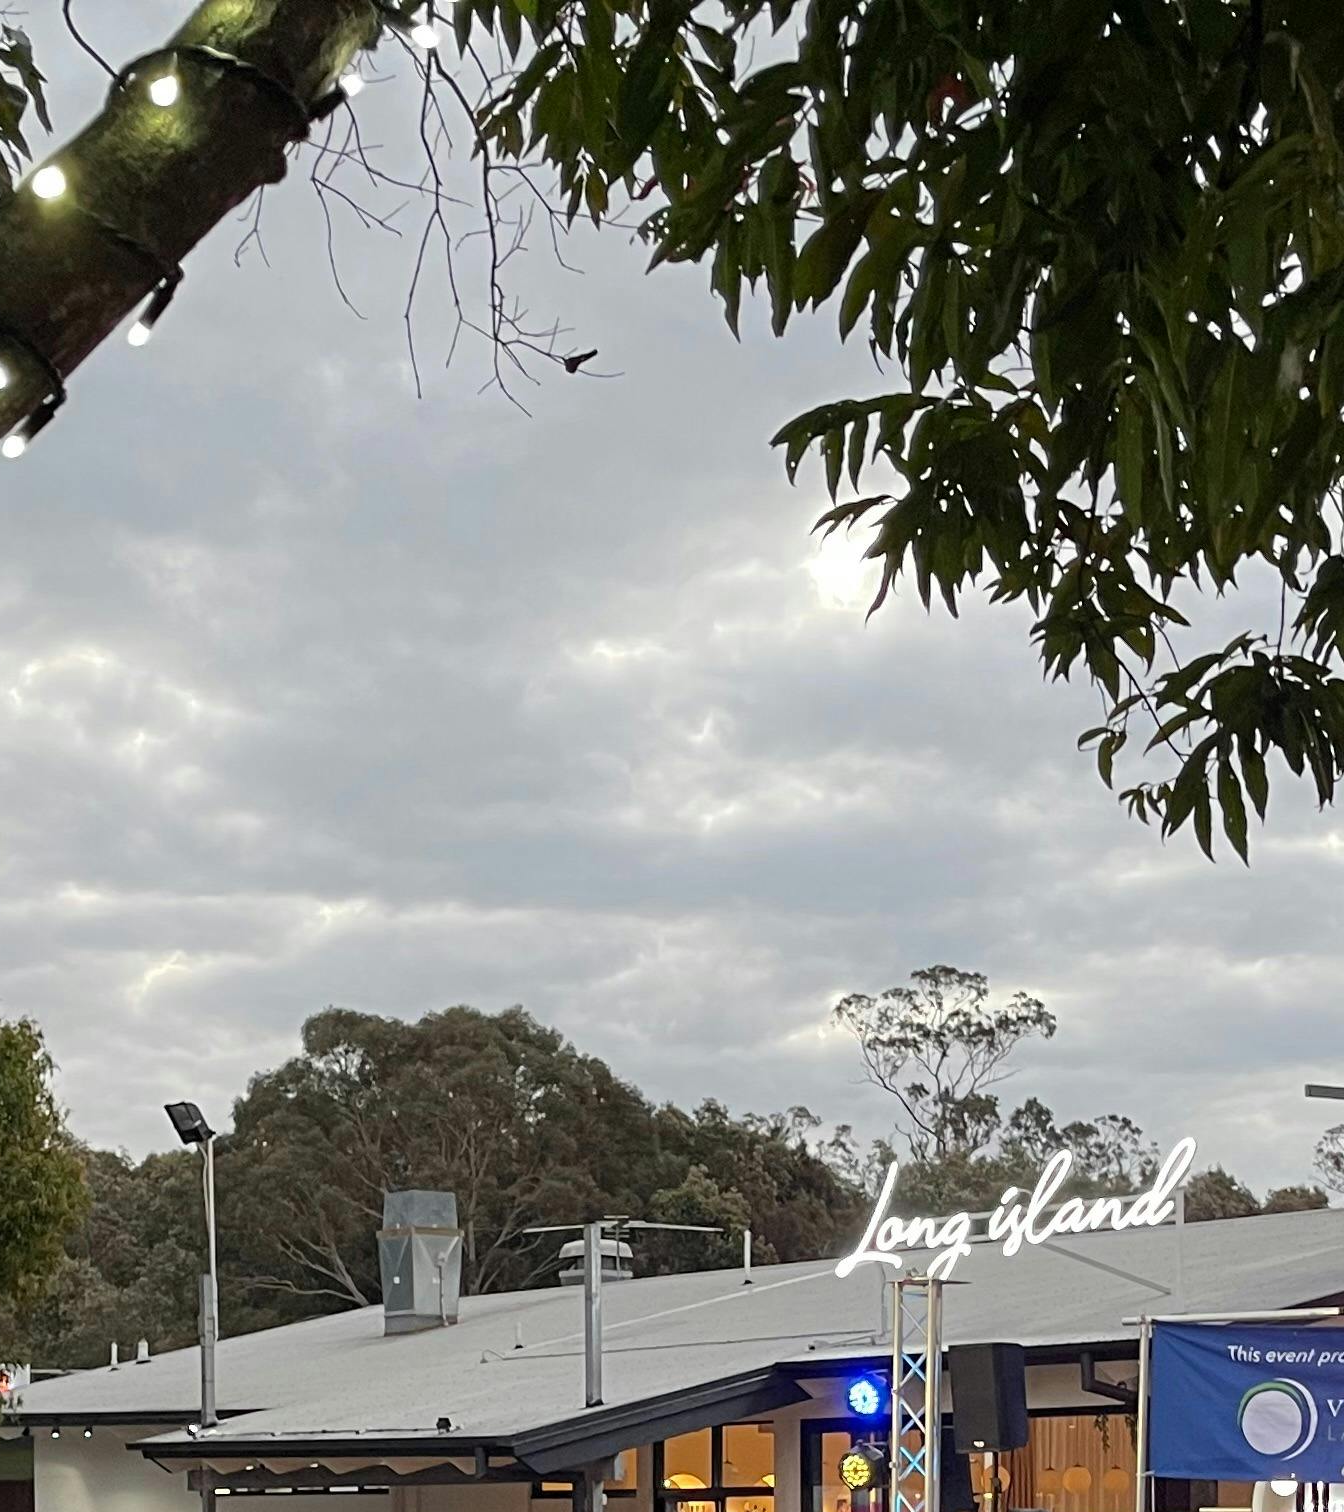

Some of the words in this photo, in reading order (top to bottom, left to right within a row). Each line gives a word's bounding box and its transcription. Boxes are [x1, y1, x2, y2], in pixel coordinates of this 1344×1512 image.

[835, 1161, 971, 1281] Long
[988, 1136, 1198, 1257] island
[1227, 1345, 1261, 1363] This
[1265, 1346, 1316, 1363] event
